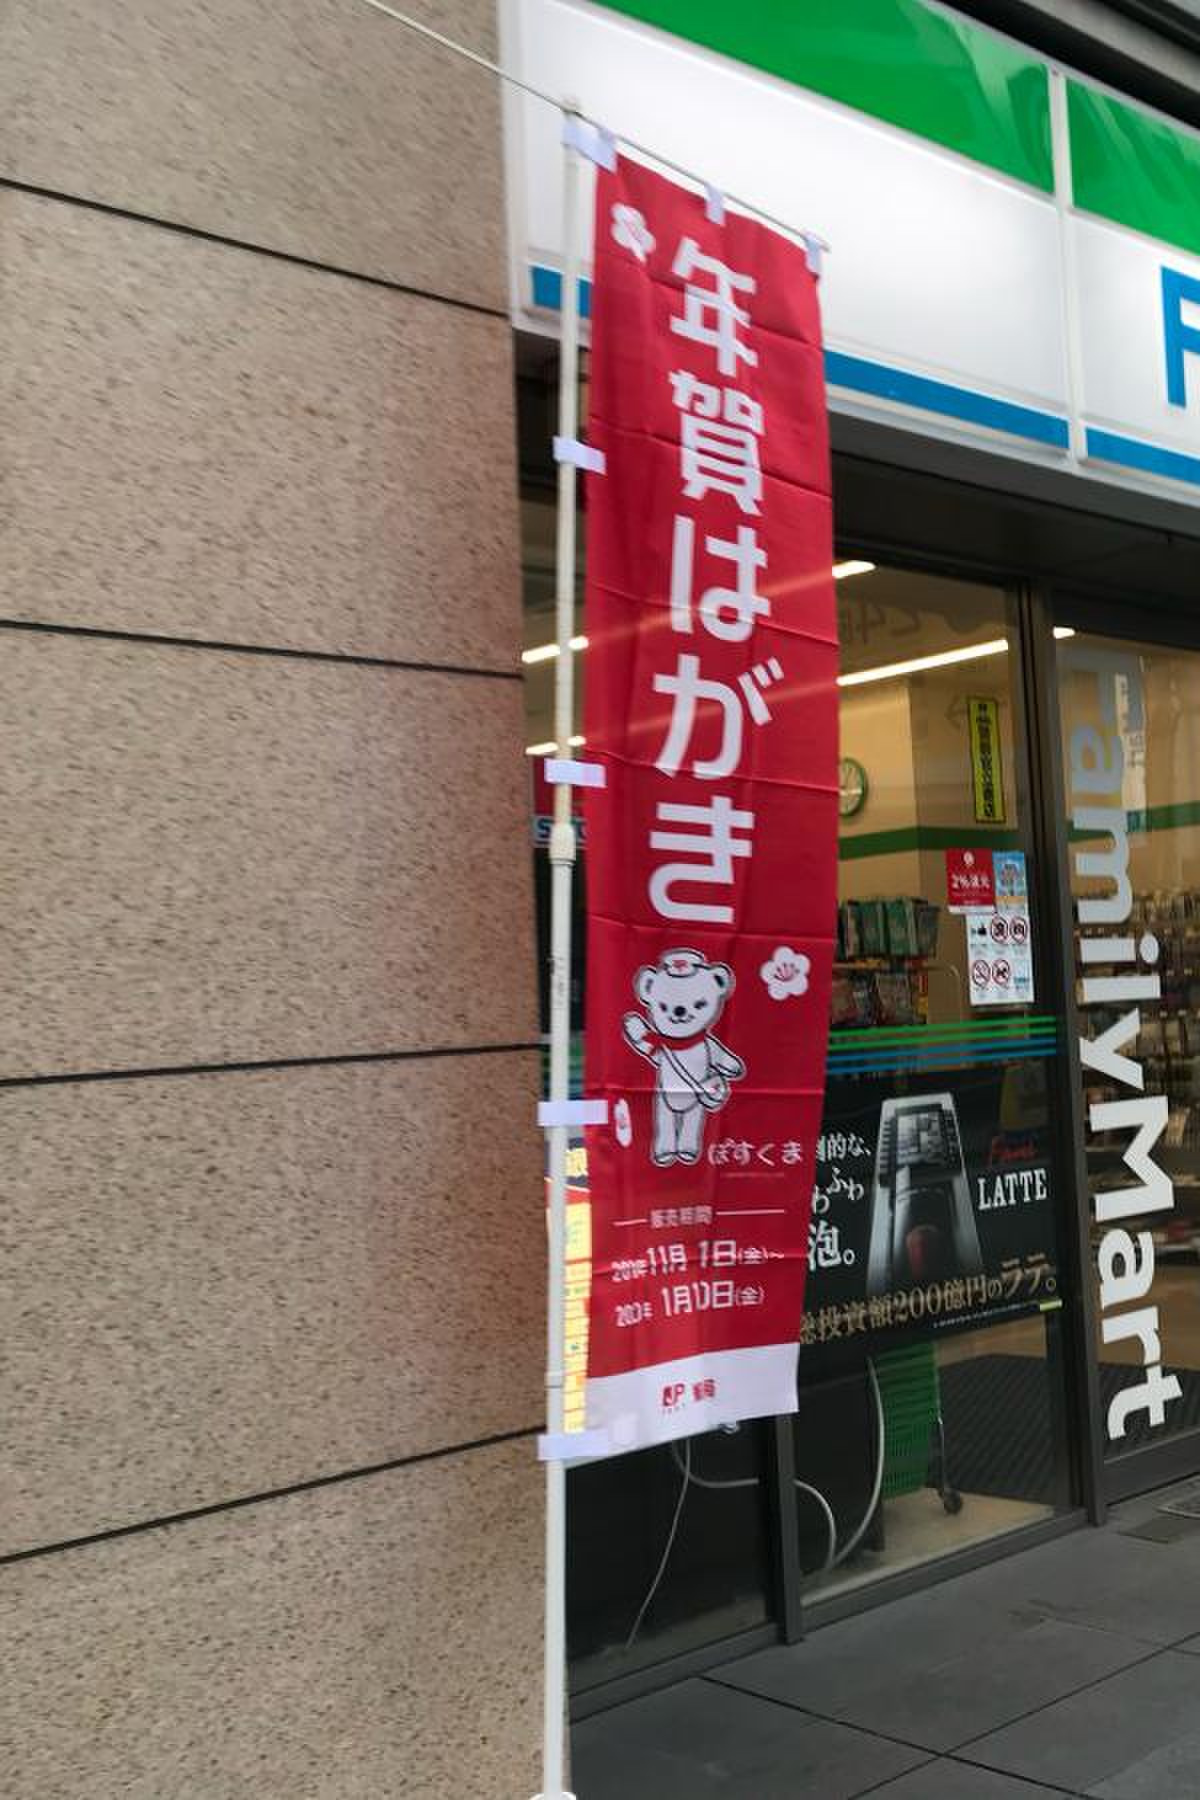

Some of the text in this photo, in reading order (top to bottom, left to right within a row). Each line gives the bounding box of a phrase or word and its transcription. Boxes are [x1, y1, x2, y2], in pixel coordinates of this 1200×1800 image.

[648, 237, 784, 924] 年賀はがき
[977, 1168, 1048, 1210] LATTE
